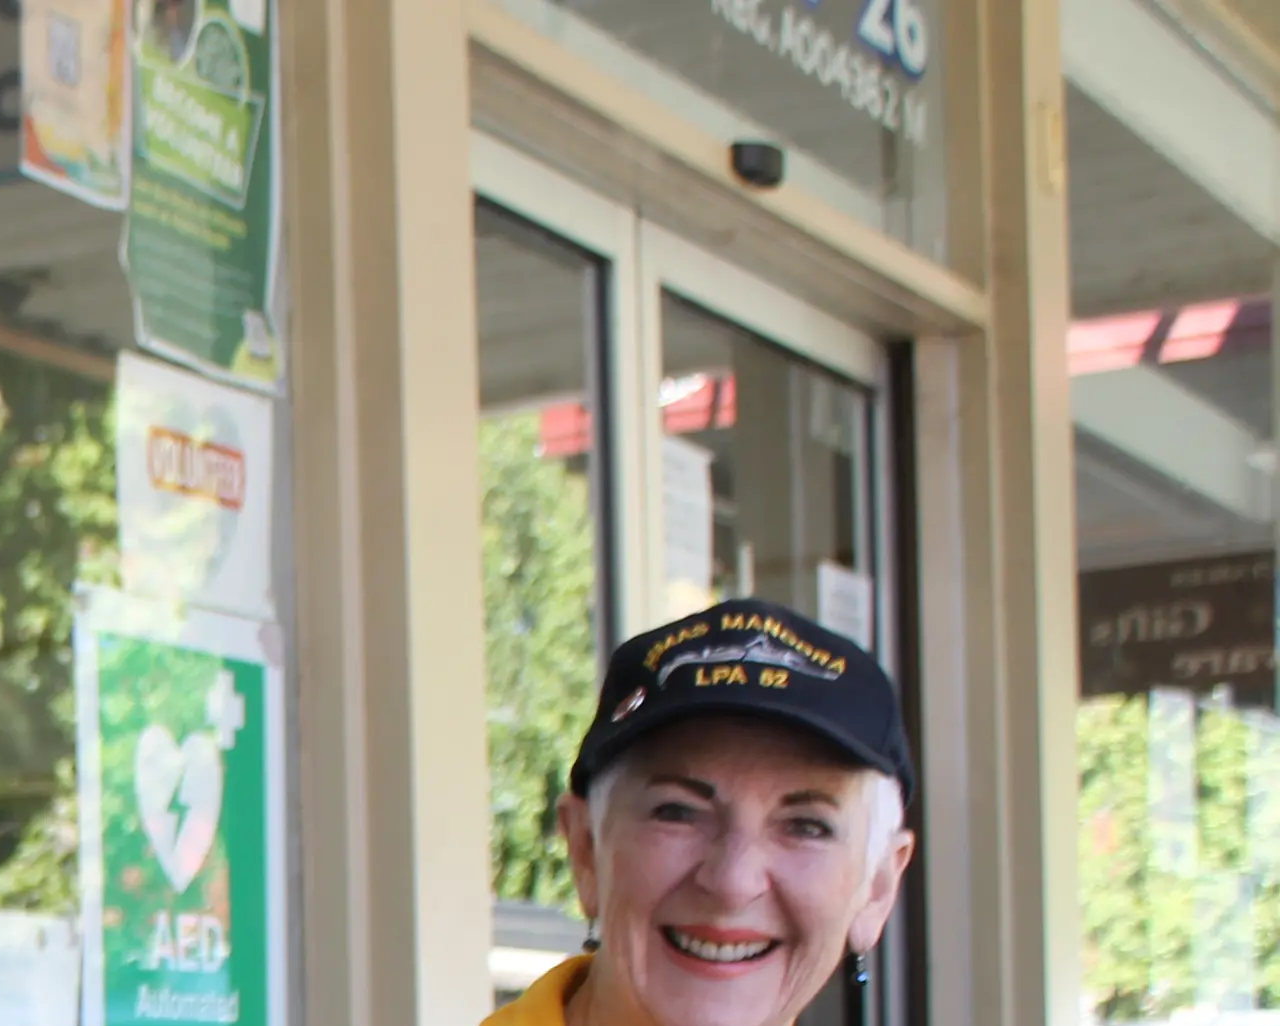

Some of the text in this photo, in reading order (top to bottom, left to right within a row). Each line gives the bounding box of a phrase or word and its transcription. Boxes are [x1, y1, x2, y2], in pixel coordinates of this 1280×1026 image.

[695, 664, 748, 686] LPA
[141, 907, 228, 973] AED
[134, 985, 239, 1023] Automated
